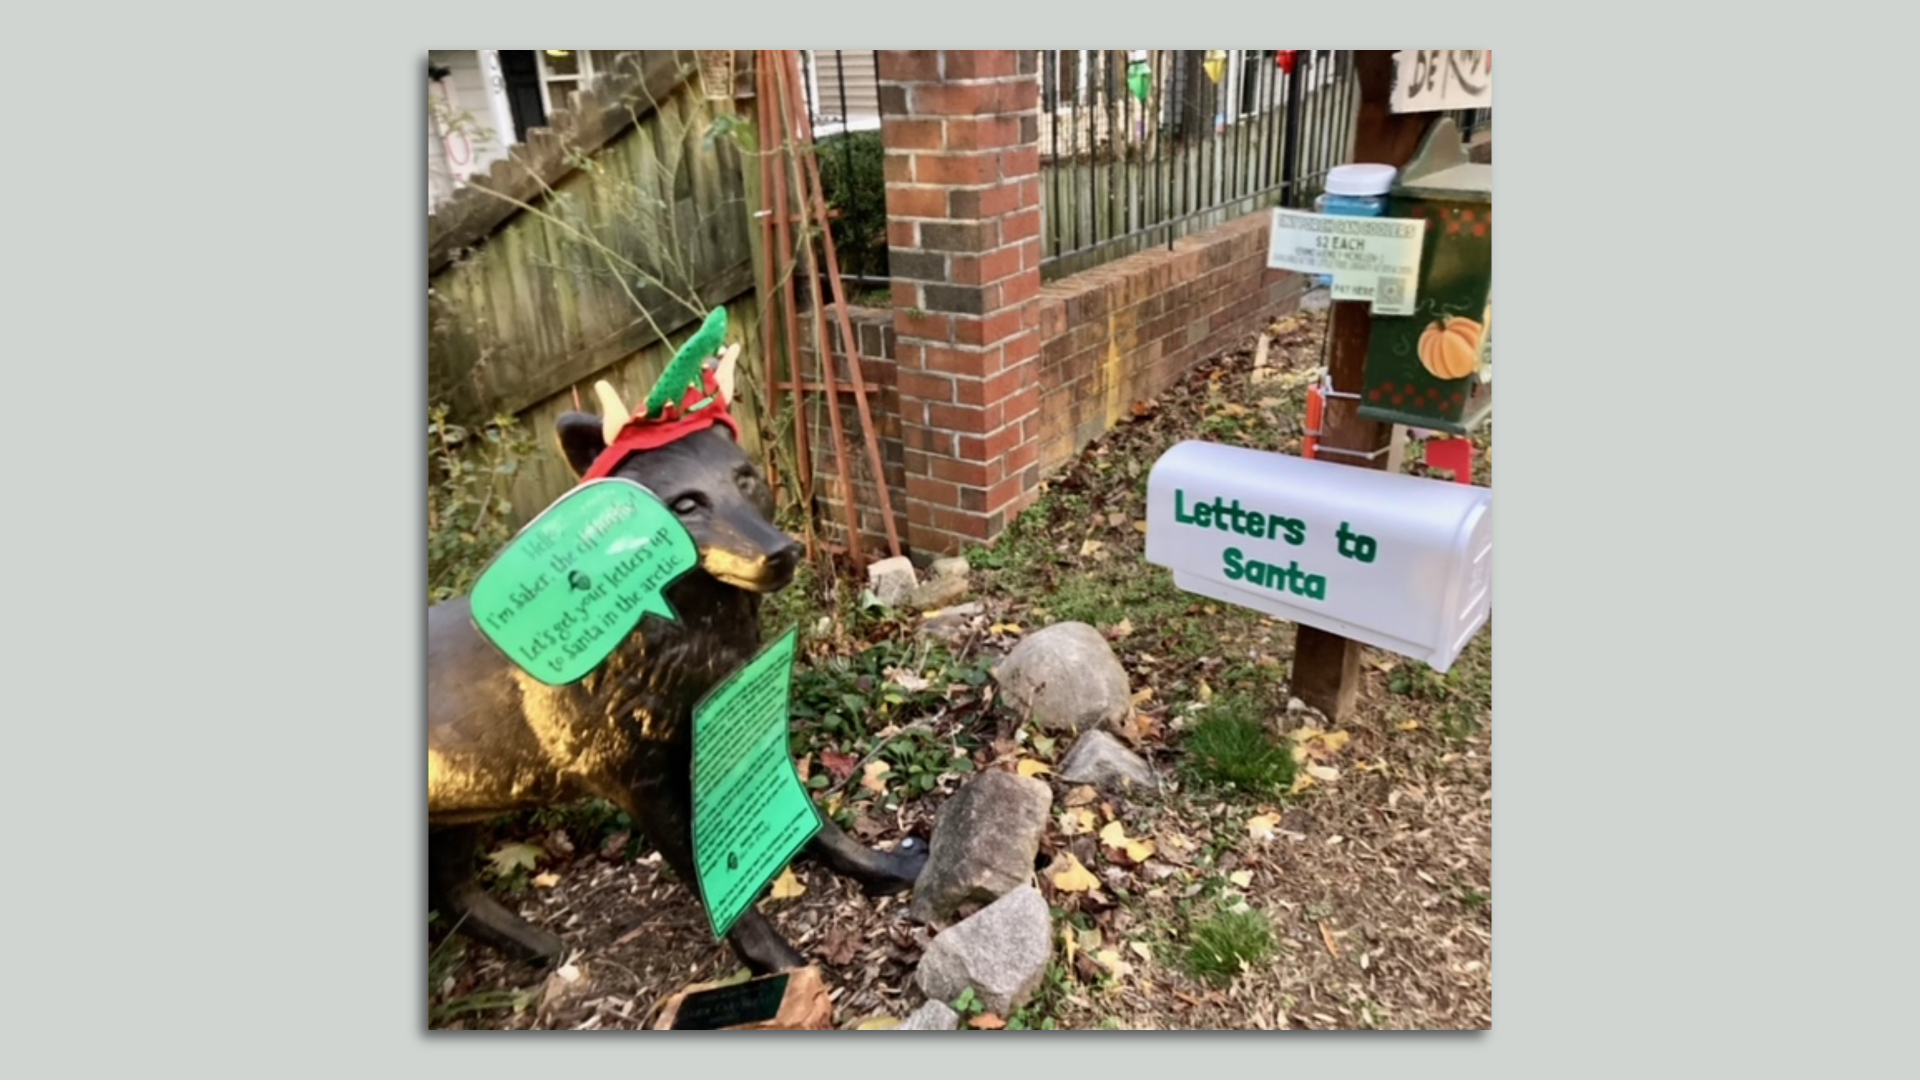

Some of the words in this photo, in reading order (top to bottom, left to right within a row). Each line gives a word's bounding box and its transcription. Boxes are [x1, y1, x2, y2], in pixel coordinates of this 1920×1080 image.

[1316, 236, 1329, 248] $2
[1332, 237, 1365, 251] EACH
[1175, 488, 1306, 546] Letters
[1336, 521, 1377, 563] to
[486, 607, 514, 630] I'm
[551, 551, 577, 574] the
[519, 631, 556, 662] Let's
[552, 611, 577, 640] get
[575, 583, 607, 622] your
[605, 545, 654, 589] letters
[651, 525, 674, 548] up
[1223, 547, 1326, 601] Santa
[548, 657, 563, 672] to
[562, 623, 605, 660] Santa
[598, 609, 618, 628] in
[615, 592, 644, 614] the
